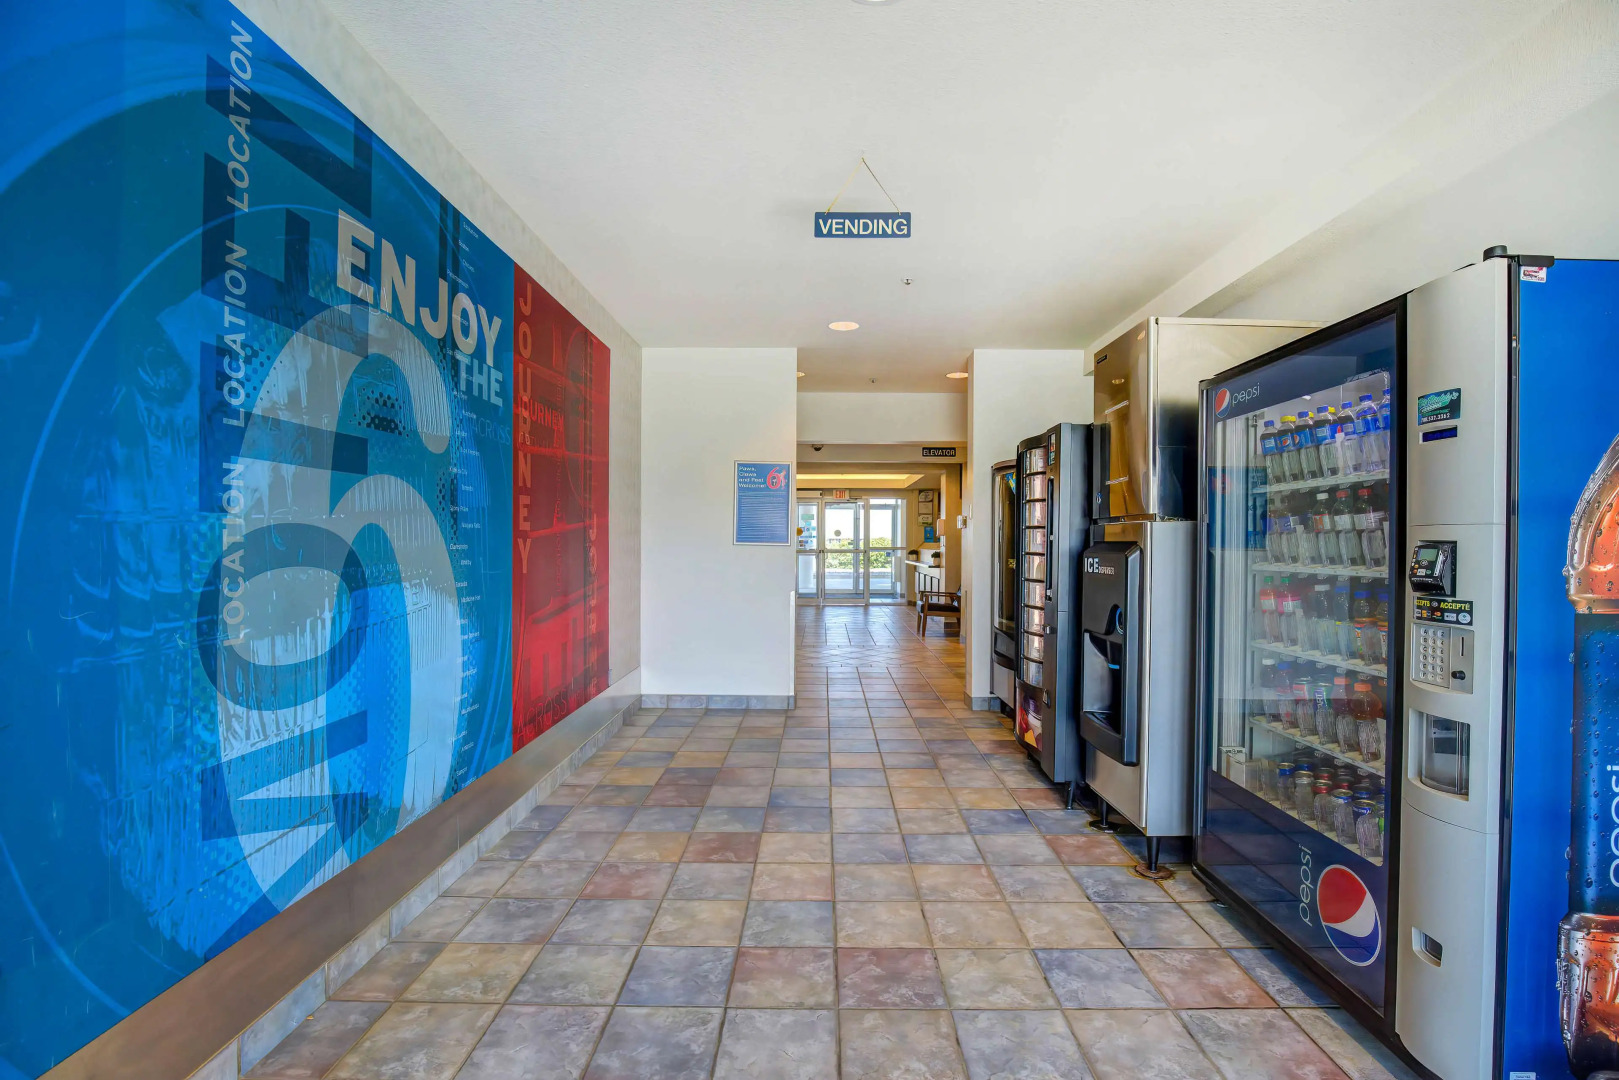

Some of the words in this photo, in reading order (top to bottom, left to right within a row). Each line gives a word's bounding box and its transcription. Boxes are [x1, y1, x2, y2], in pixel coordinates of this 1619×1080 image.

[227, 20, 253, 213] LOCATION
[818, 218, 908, 235] VENDING
[336, 208, 503, 368] ENJOY
[224, 241, 249, 428] LOCATION
[455, 350, 504, 408] THE
[1232, 382, 1260, 407] pepsi
[517, 282, 532, 574] JOURNEY
[923, 448, 955, 457] ELEVATOR
[835, 489, 846, 499] EXIT
[222, 461, 247, 648] LOCATION
[1084, 556, 1099, 573] ICE
[1440, 601, 1470, 611] ACCEPTÉ
[1299, 843, 1314, 927] pepsi
